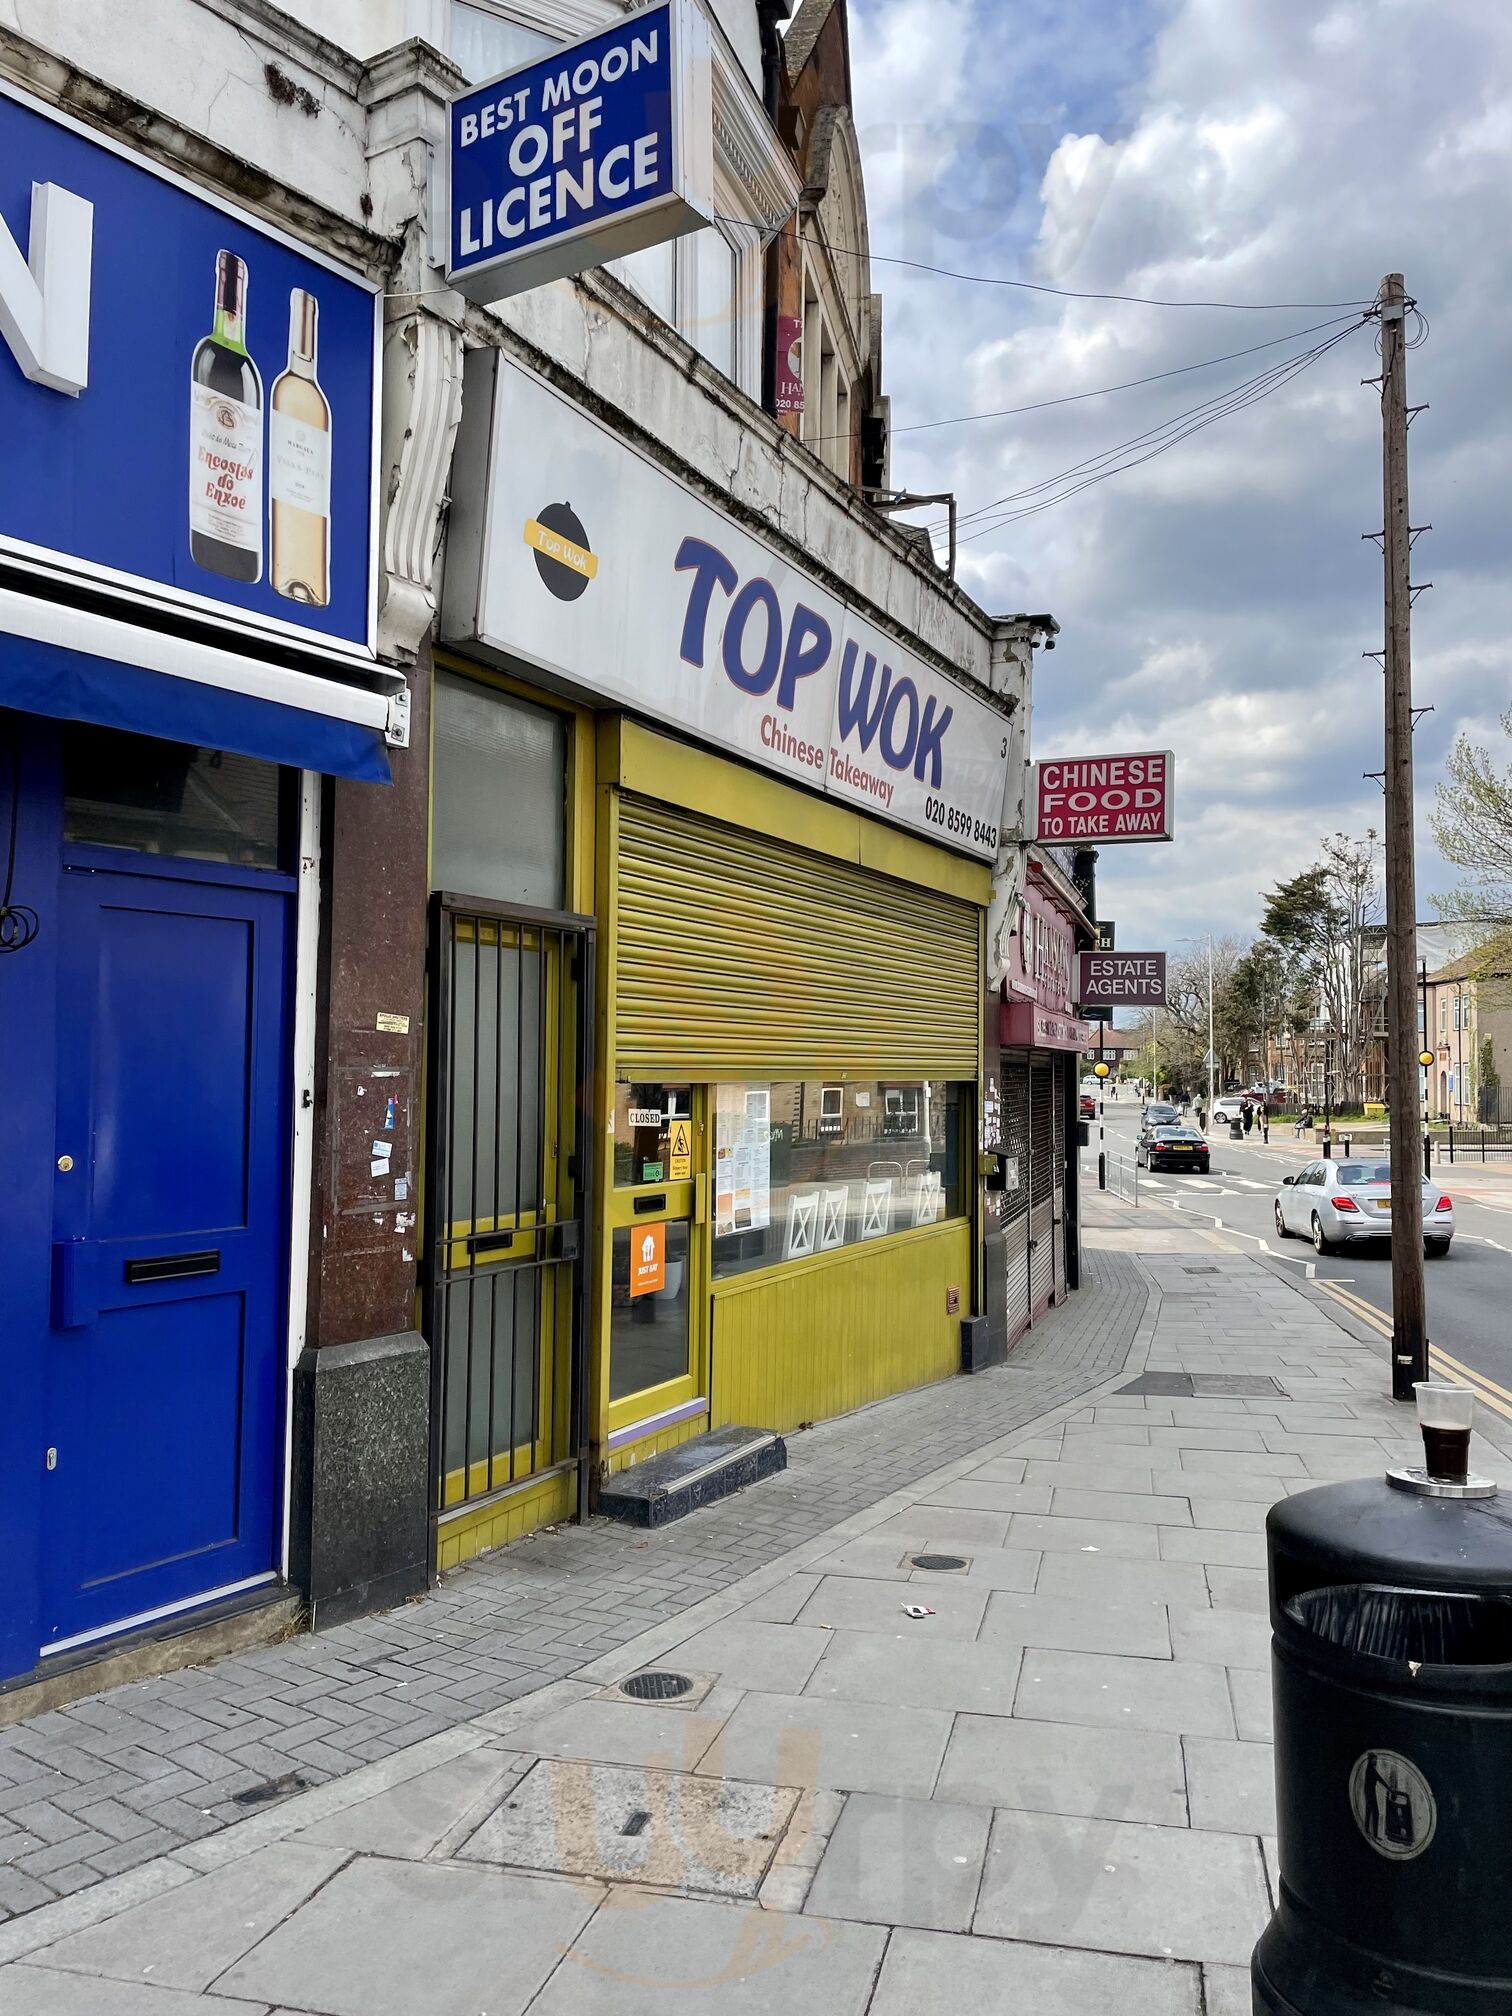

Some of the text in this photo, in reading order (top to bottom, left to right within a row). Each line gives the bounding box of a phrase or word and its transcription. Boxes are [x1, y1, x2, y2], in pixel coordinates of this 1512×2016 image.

[461, 30, 658, 147] BEST MOON
[508, 96, 602, 176] OFF
[460, 132, 658, 256] LICENCE
[198, 445, 253, 481] Encostas
[217, 473, 234, 490] do
[538, 530, 586, 570] Top Wok
[674, 536, 954, 790] TOP WOK
[760, 714, 824, 769] Chinese
[830, 747, 894, 809] Takeaway
[1001, 737, 1007, 758] 3
[1042, 759, 1164, 790] CHINESE
[1043, 788, 1162, 813] FOOD
[925, 796, 997, 848] 020 8599 8443
[1042, 812, 1162, 837] TO TAKE AWAY
[1091, 960, 1157, 976] ESTATE
[1086, 978, 1162, 995] AGENTS
[630, 1113, 660, 1123] CLOSED
[638, 1265, 649, 1277] JUST
